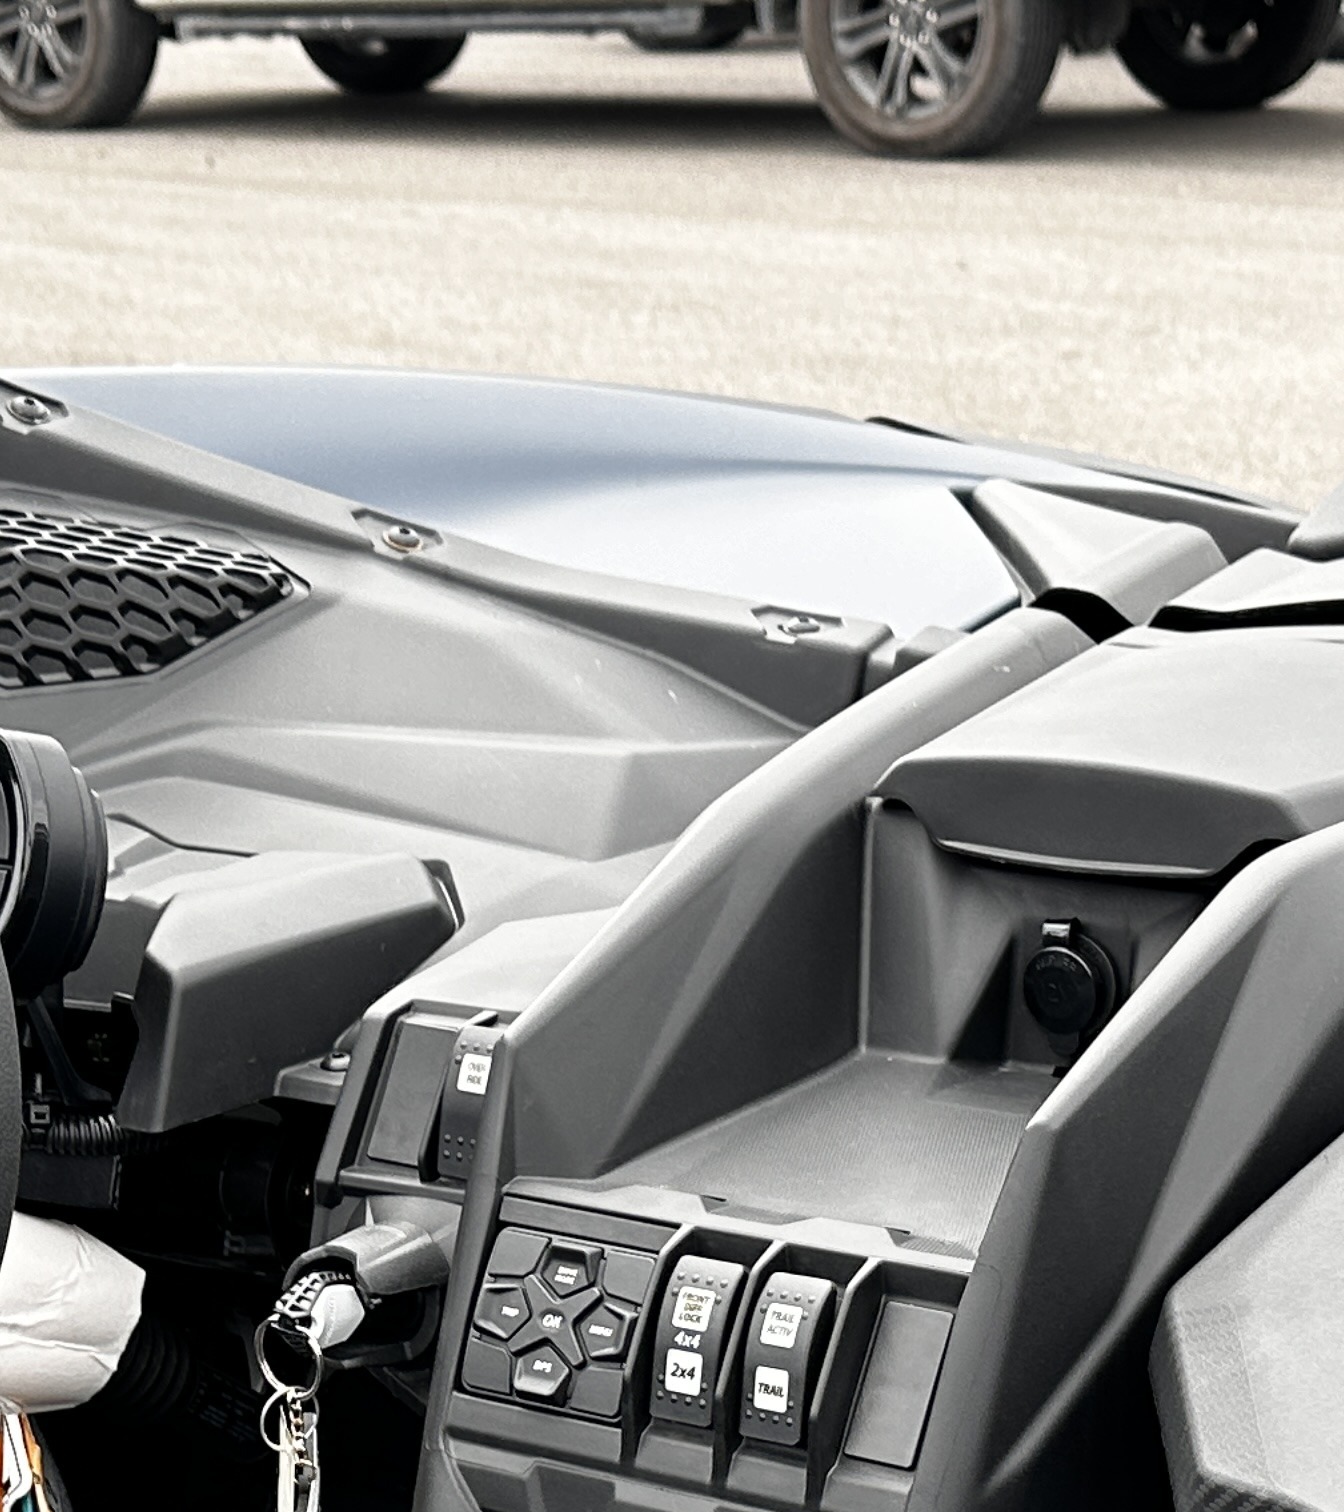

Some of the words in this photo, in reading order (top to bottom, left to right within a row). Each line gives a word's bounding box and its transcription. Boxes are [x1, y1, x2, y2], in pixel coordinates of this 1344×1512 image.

[542, 1314, 563, 1329] OK
[771, 1311, 794, 1323] TRAIL
[674, 1330, 701, 1349] 4x4
[670, 1362, 696, 1380] 2x4
[758, 1382, 785, 1398] TRAIL
